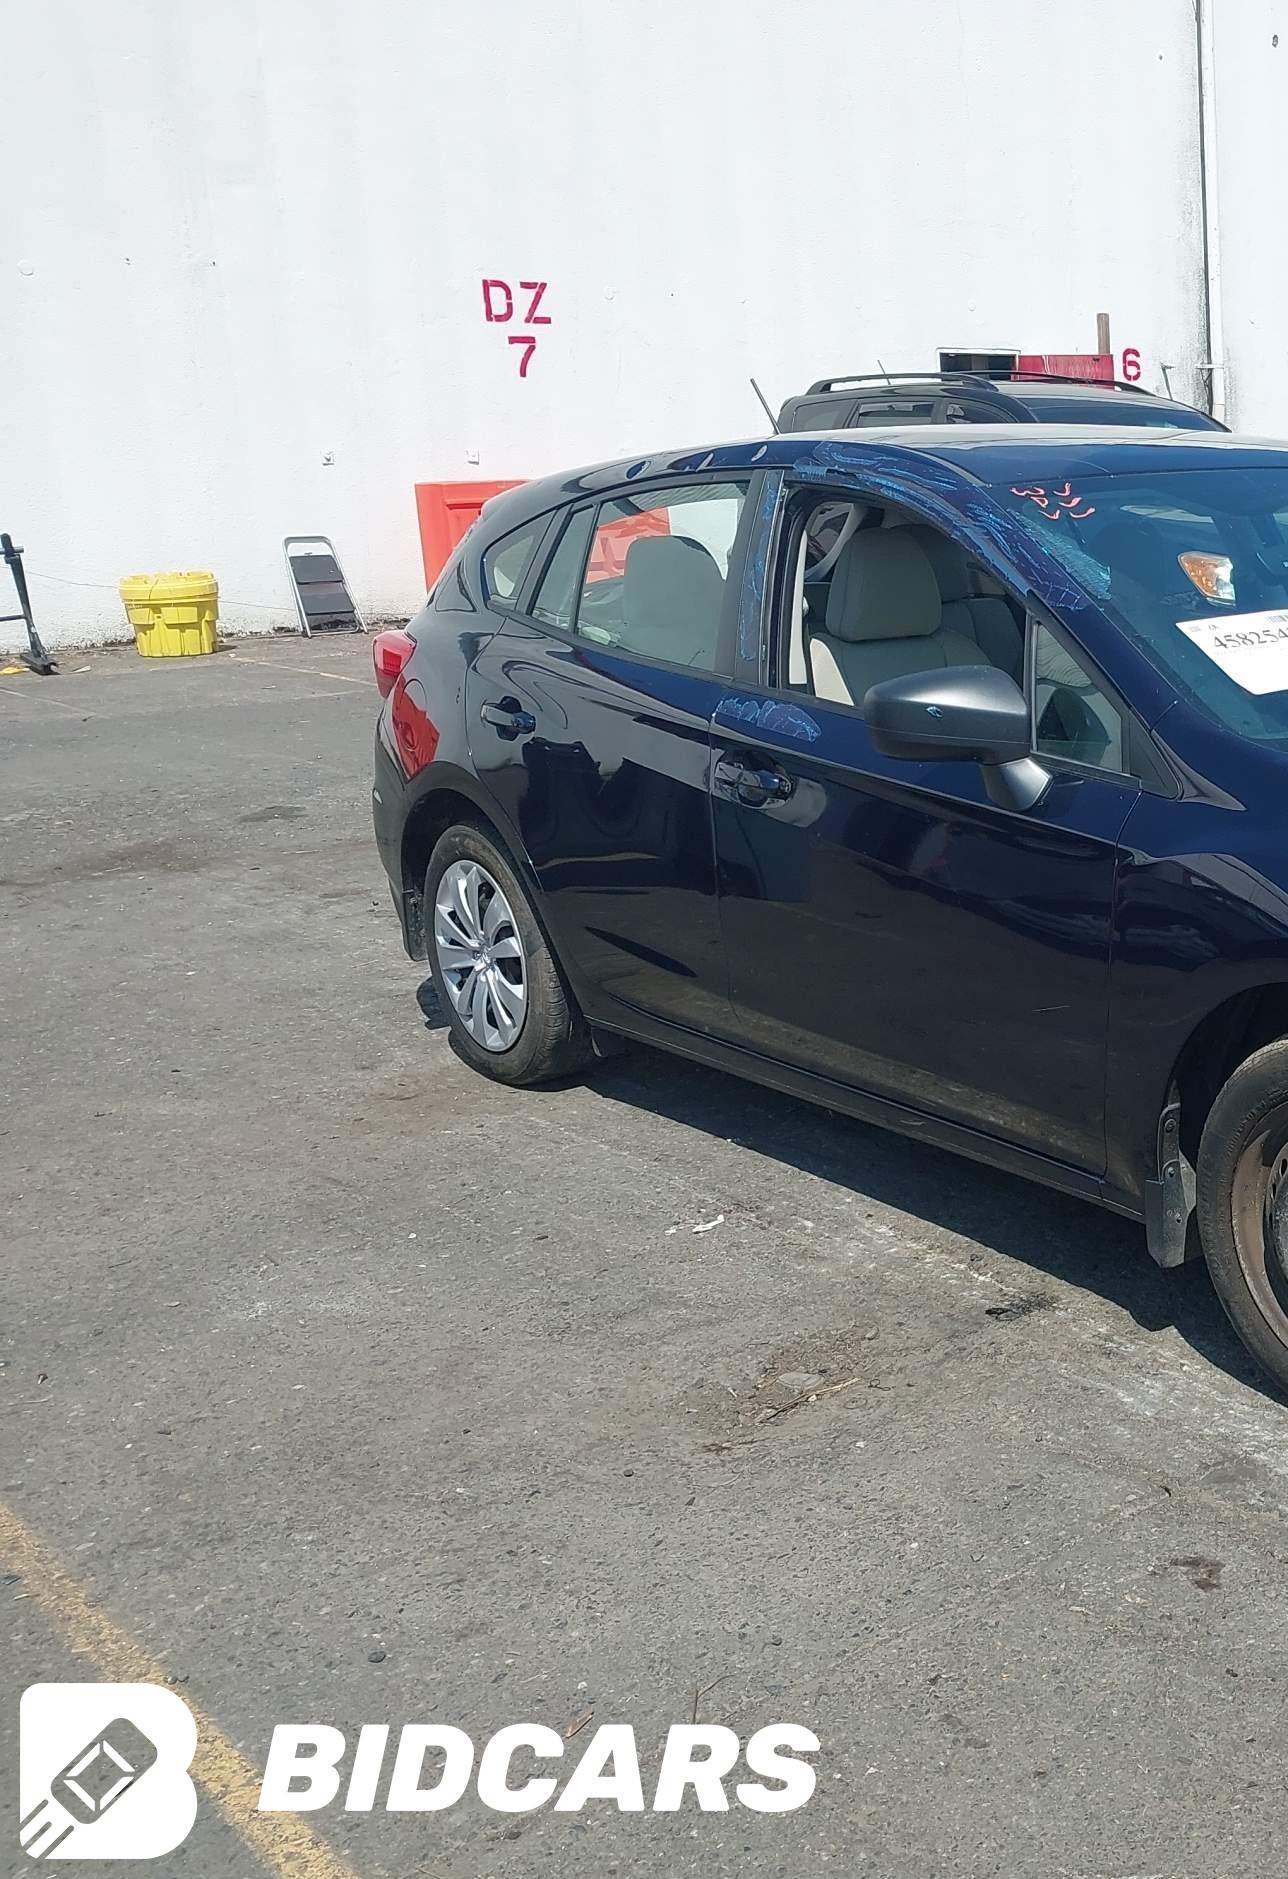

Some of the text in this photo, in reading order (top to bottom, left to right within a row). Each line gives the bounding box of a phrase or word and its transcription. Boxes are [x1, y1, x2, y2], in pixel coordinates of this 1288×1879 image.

[482, 279, 552, 324] DZ
[508, 335, 537, 378] 7
[1122, 348, 1141, 382] 6
